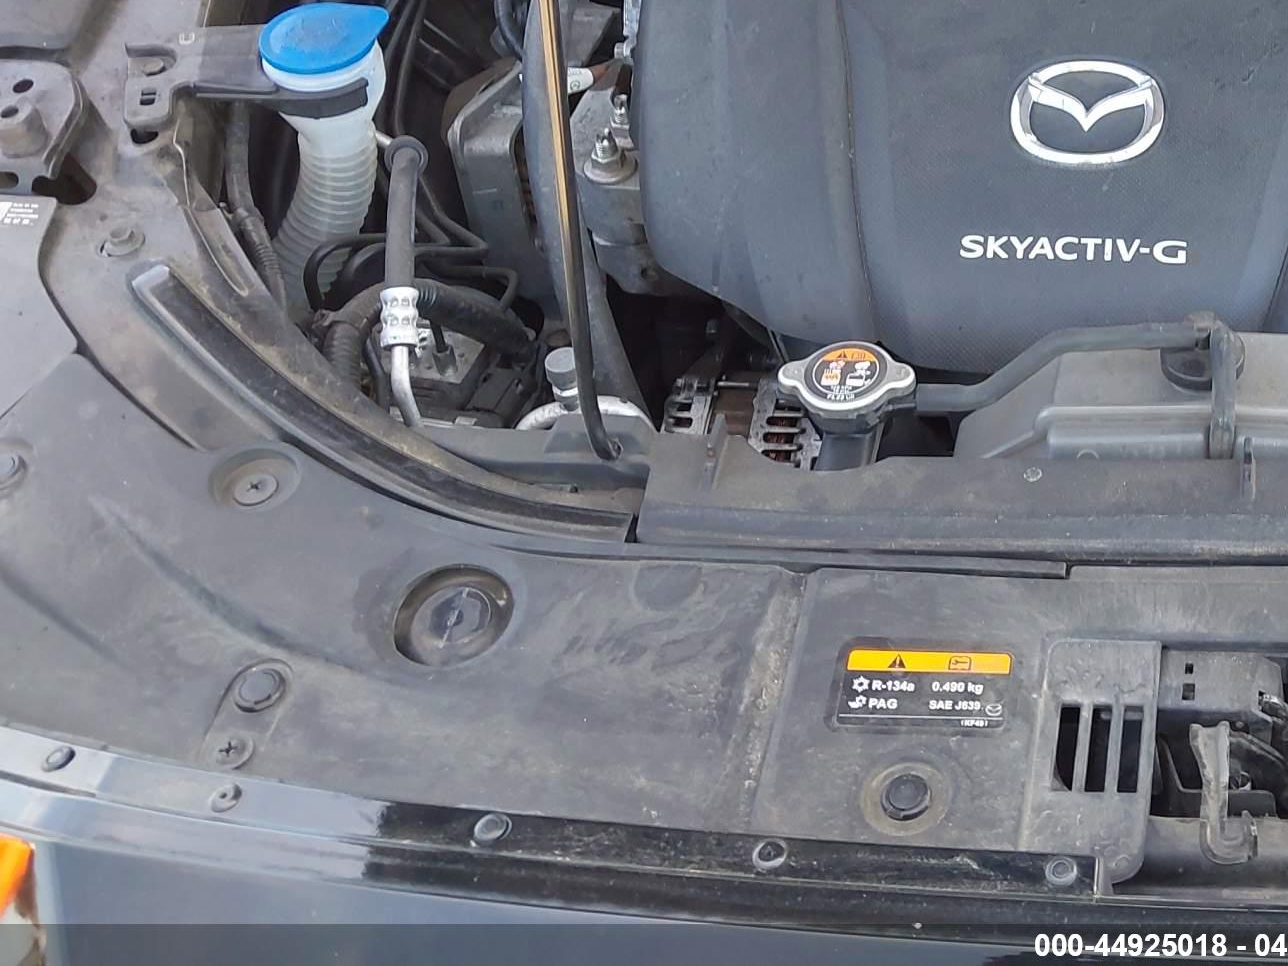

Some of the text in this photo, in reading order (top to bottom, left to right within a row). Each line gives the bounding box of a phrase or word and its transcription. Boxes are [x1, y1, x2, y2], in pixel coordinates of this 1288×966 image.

[959, 234, 1187, 264] SKYACTIV-G
[871, 679, 984, 695] R-134a 0.490 kg
[868, 697, 898, 709] PAG
[929, 700, 953, 710] SAE
